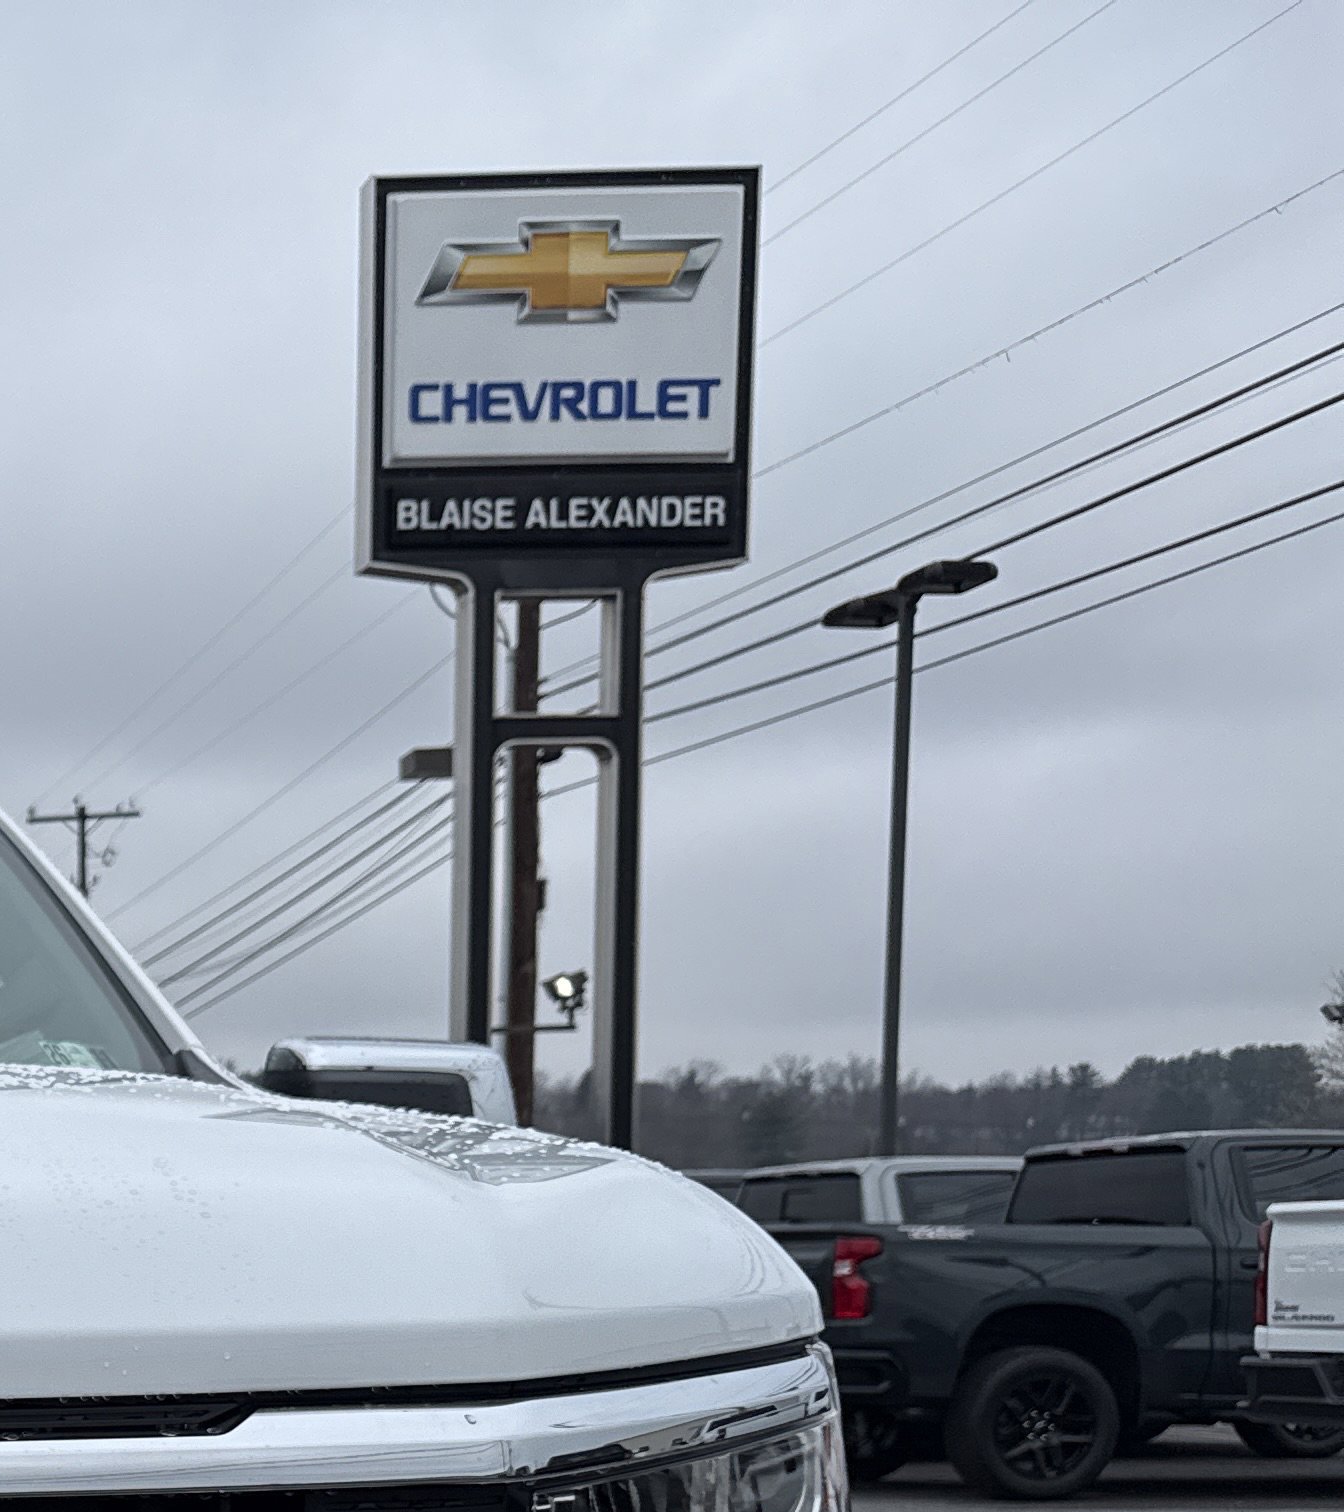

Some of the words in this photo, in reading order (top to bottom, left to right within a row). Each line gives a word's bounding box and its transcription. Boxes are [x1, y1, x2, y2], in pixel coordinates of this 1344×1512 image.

[408, 378, 721, 424] CHEVROLET
[395, 498, 516, 531] BLAISE
[524, 495, 727, 529] ALEXANDER
